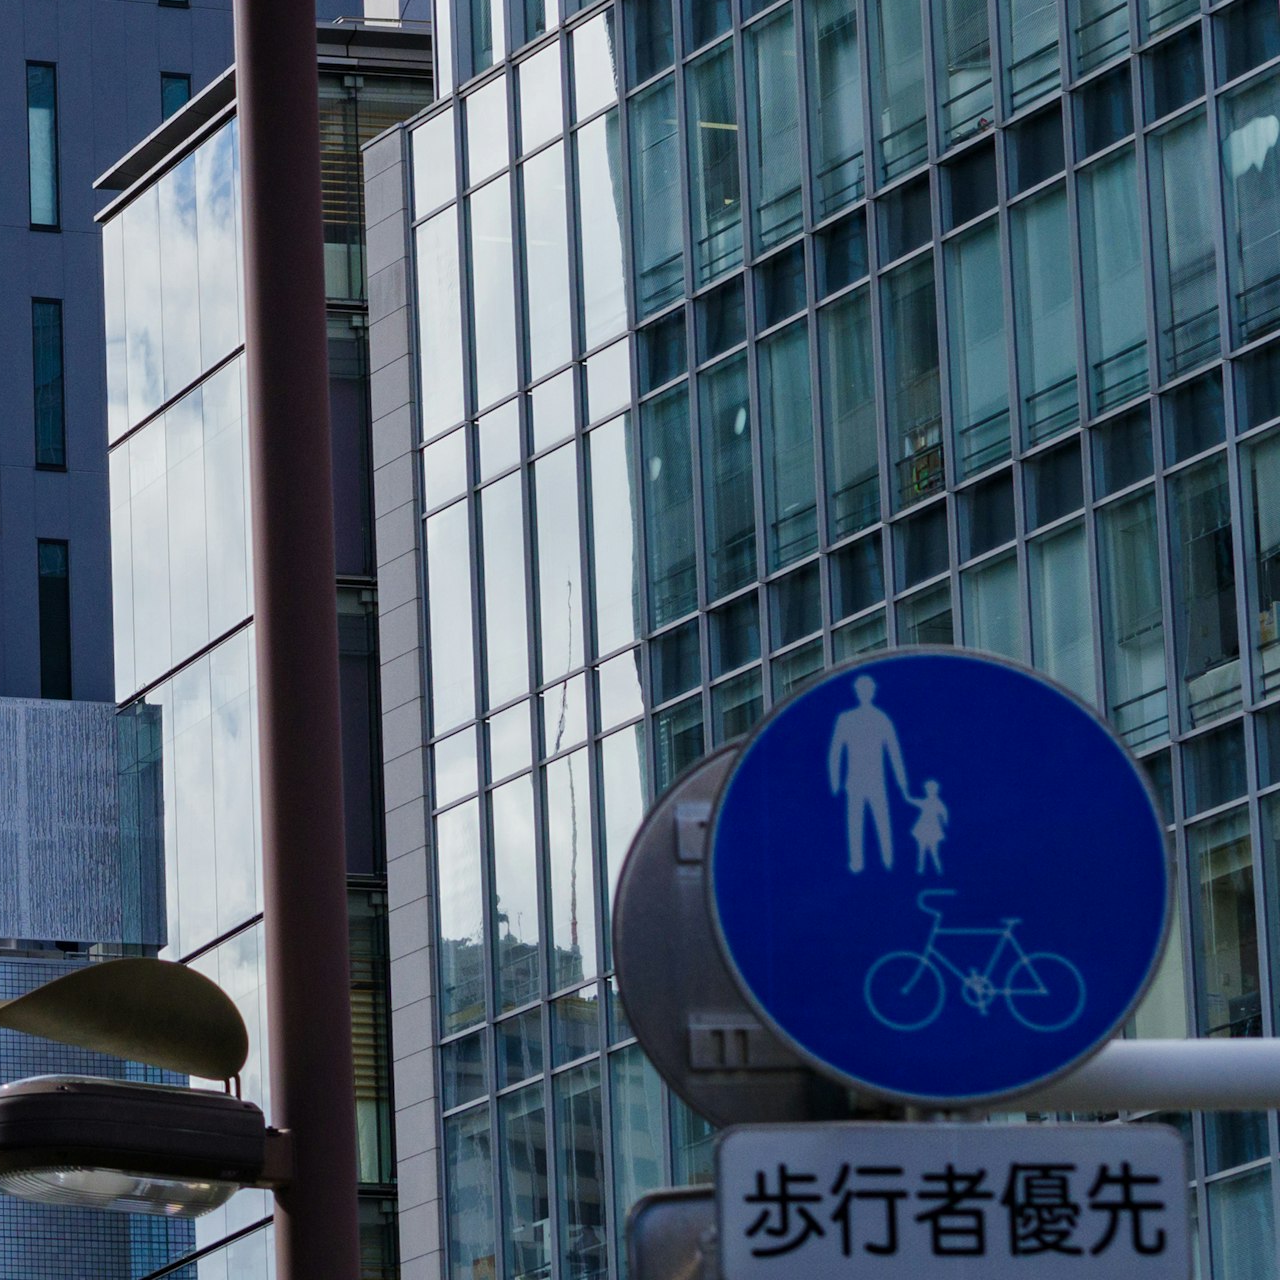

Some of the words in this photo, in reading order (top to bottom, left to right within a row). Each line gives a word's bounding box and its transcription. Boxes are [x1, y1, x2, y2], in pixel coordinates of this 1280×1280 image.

[744, 1161, 1167, 1258] 歩行者優先
